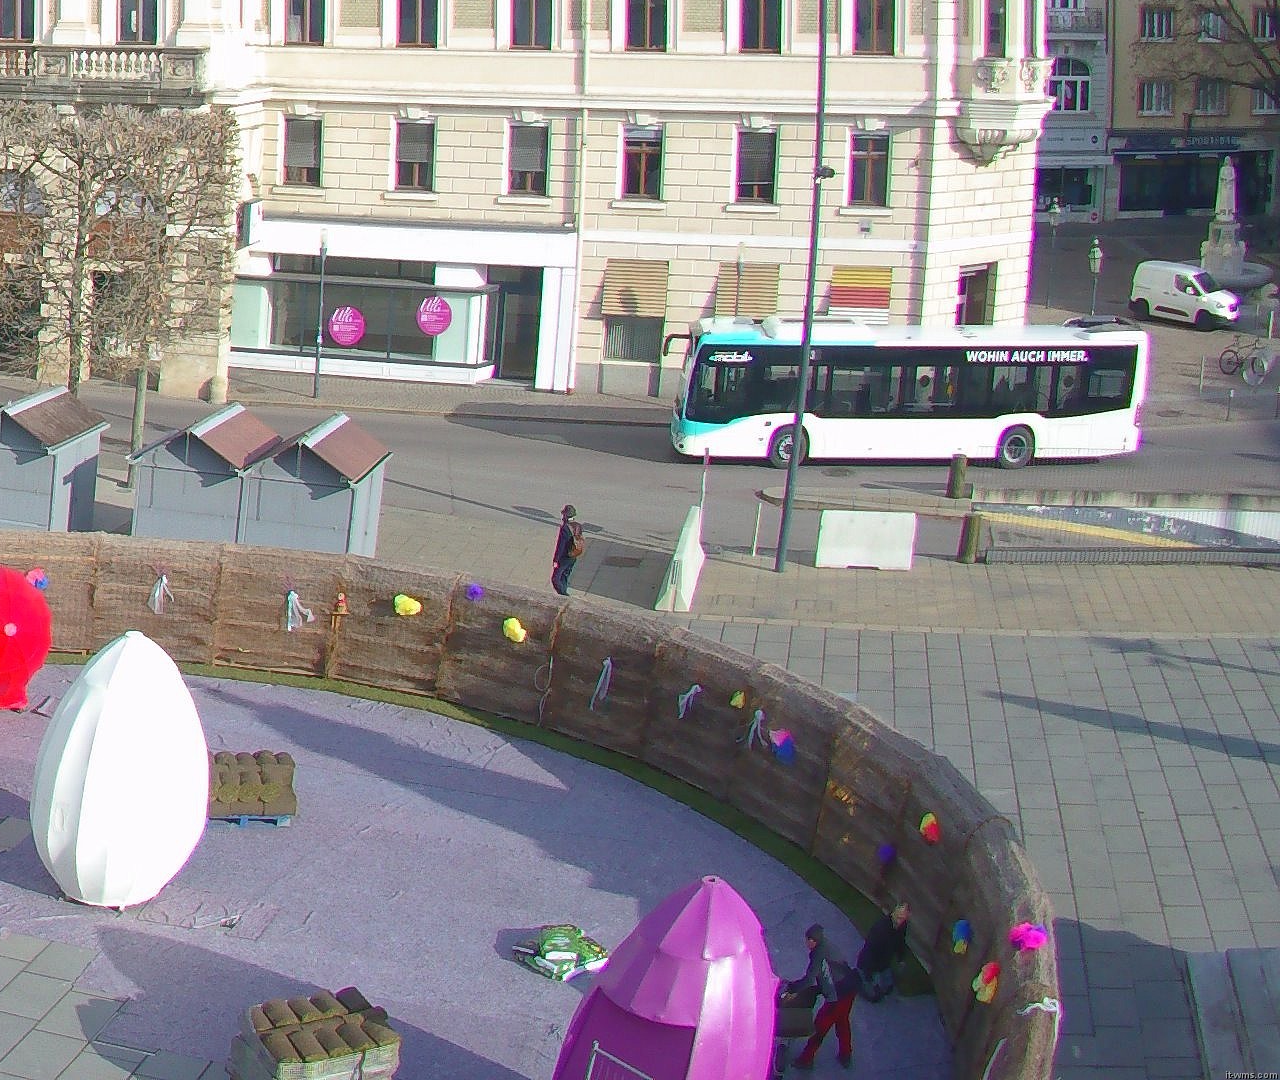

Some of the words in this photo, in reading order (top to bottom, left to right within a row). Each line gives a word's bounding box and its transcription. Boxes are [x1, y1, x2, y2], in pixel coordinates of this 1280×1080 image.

[966, 350, 1009, 362] WOHIN
[1011, 350, 1045, 362] AUCH
[1047, 350, 1089, 362] IMMER.
